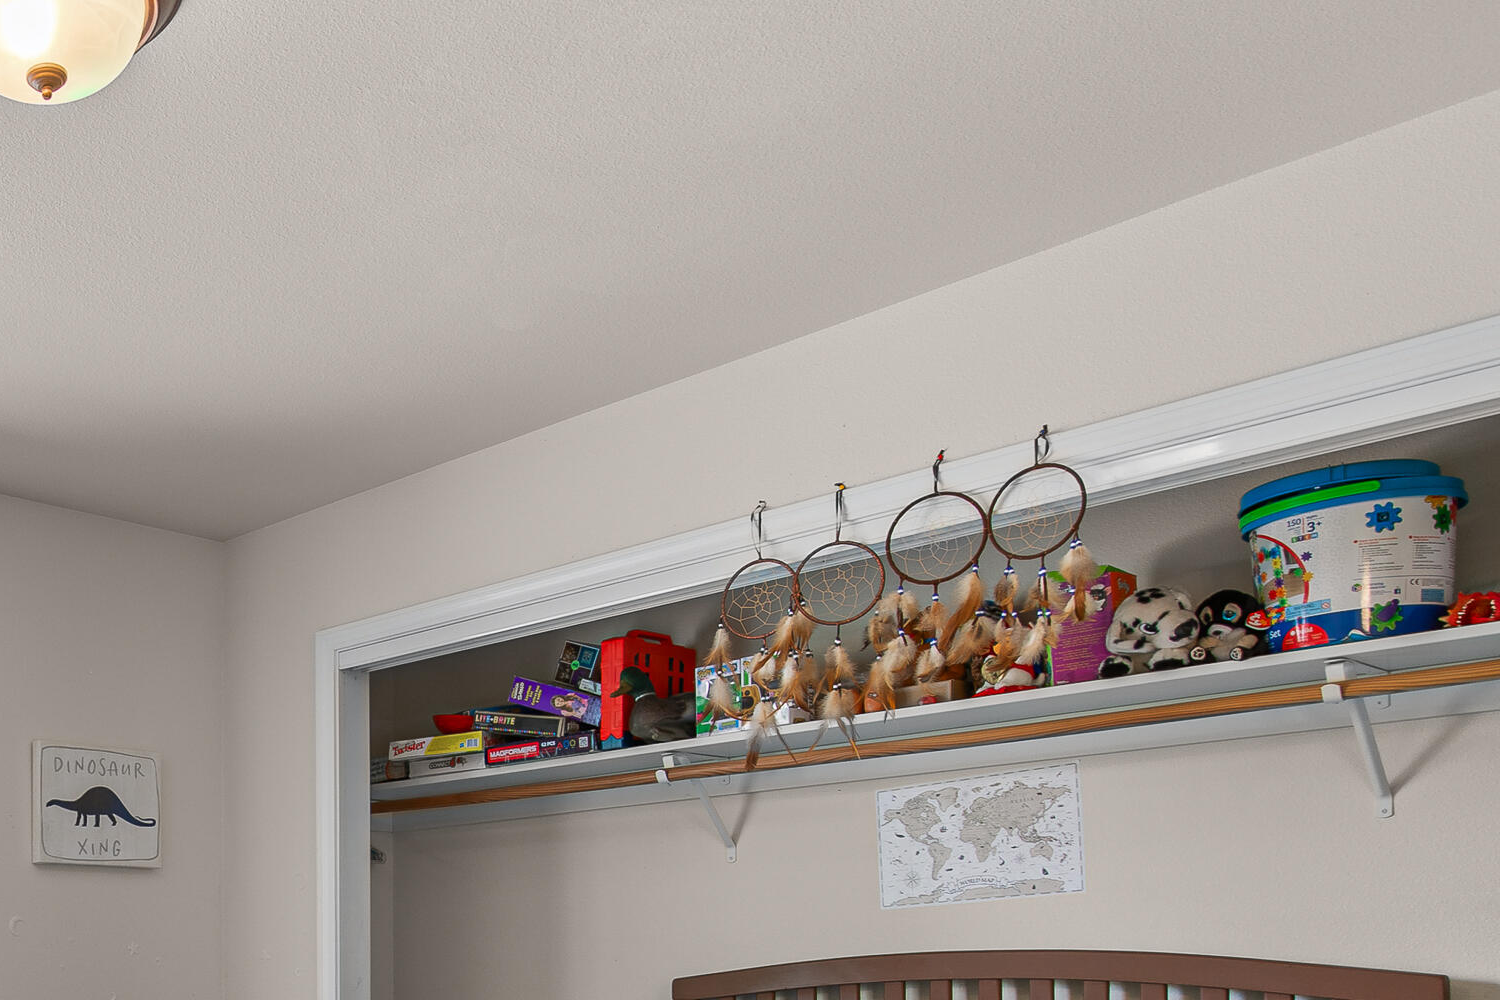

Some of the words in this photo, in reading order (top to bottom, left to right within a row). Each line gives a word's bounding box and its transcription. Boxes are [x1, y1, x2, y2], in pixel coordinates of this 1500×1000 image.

[392, 741, 426, 757] Twister
[54, 756, 146, 779] DINOSAUR
[77, 838, 122, 857] XING
